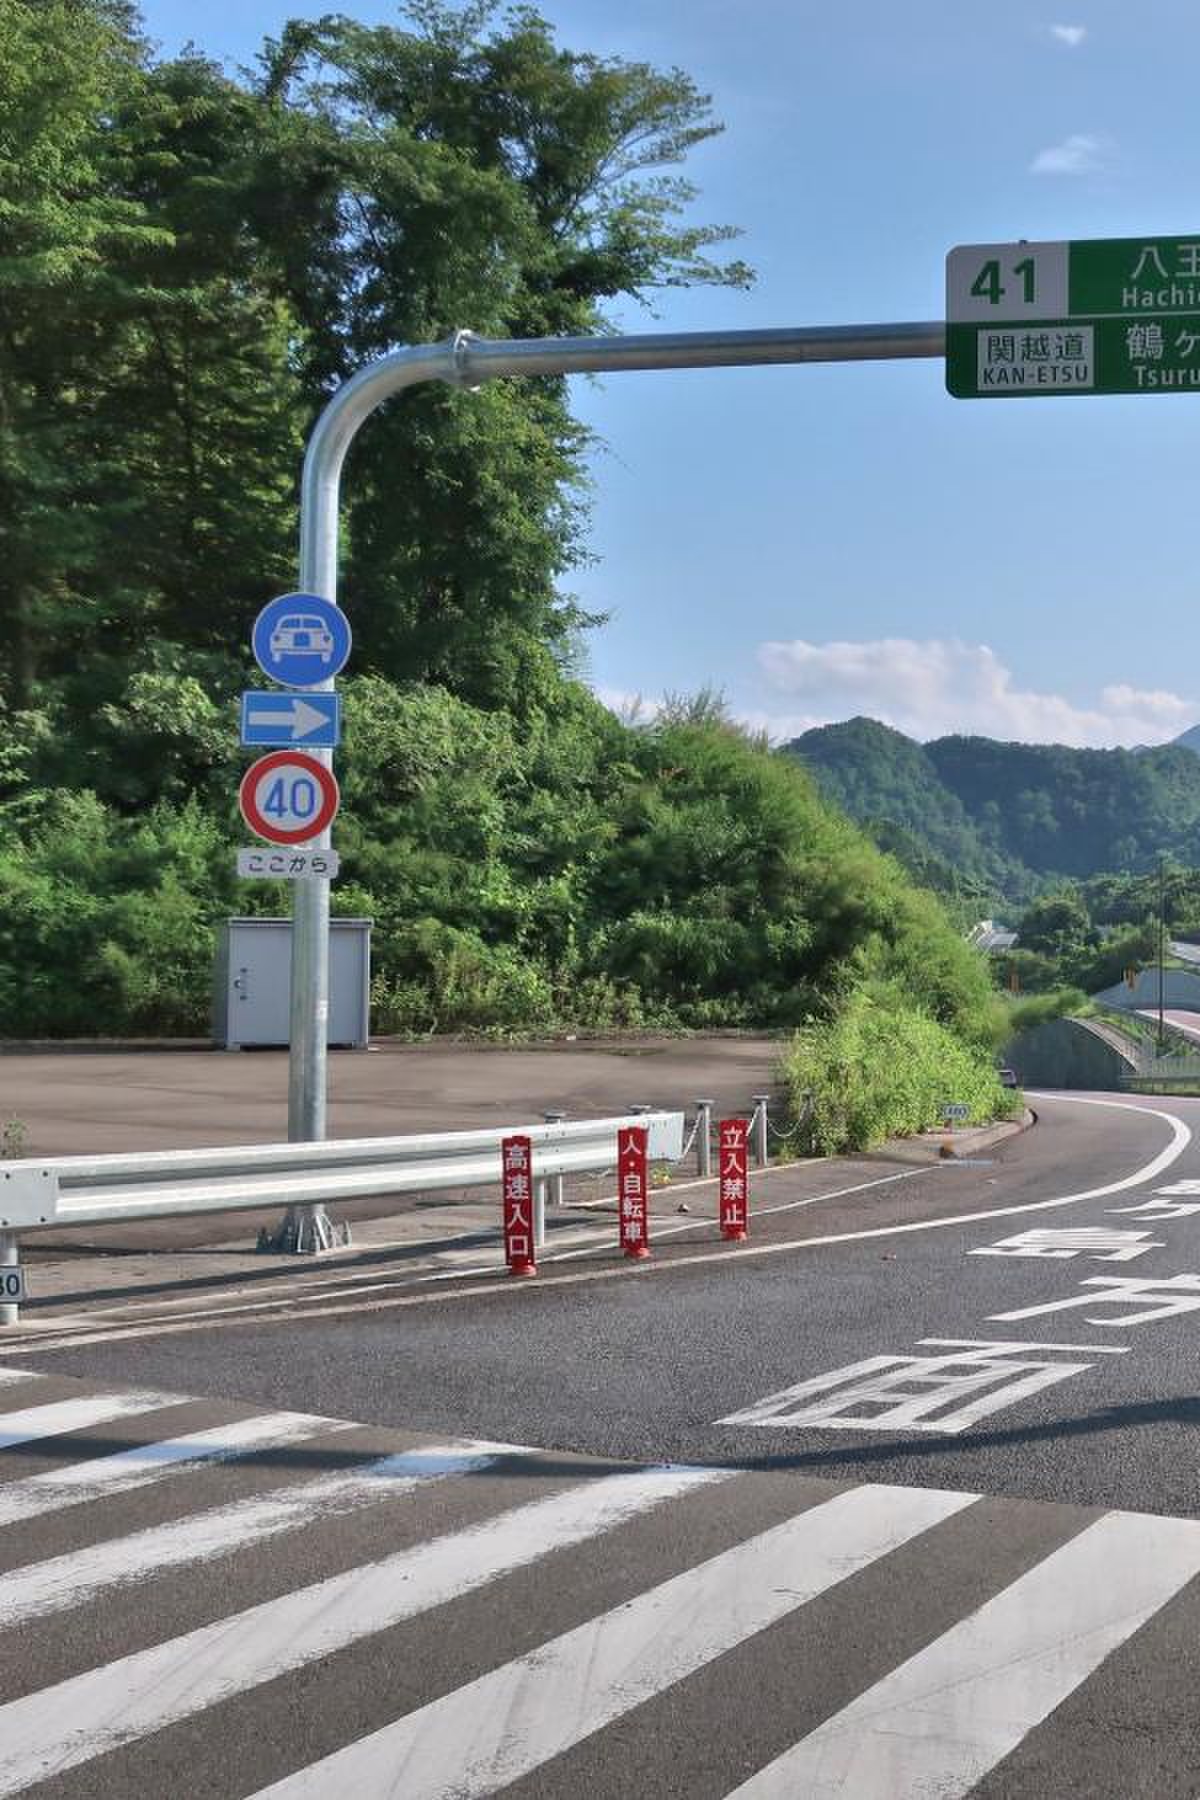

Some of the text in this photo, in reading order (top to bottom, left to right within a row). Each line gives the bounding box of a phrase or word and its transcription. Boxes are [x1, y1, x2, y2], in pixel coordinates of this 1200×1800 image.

[970, 258, 1036, 304] 41
[987, 332, 1086, 364] 関越道
[983, 366, 1088, 386] KAN-ETSU
[263, 777, 316, 819] 40
[249, 856, 328, 873] ここから
[621, 1135, 644, 1243] 人・自転車
[722, 1126, 745, 1226] 立入禁止
[505, 1145, 530, 1256] 高速入口
